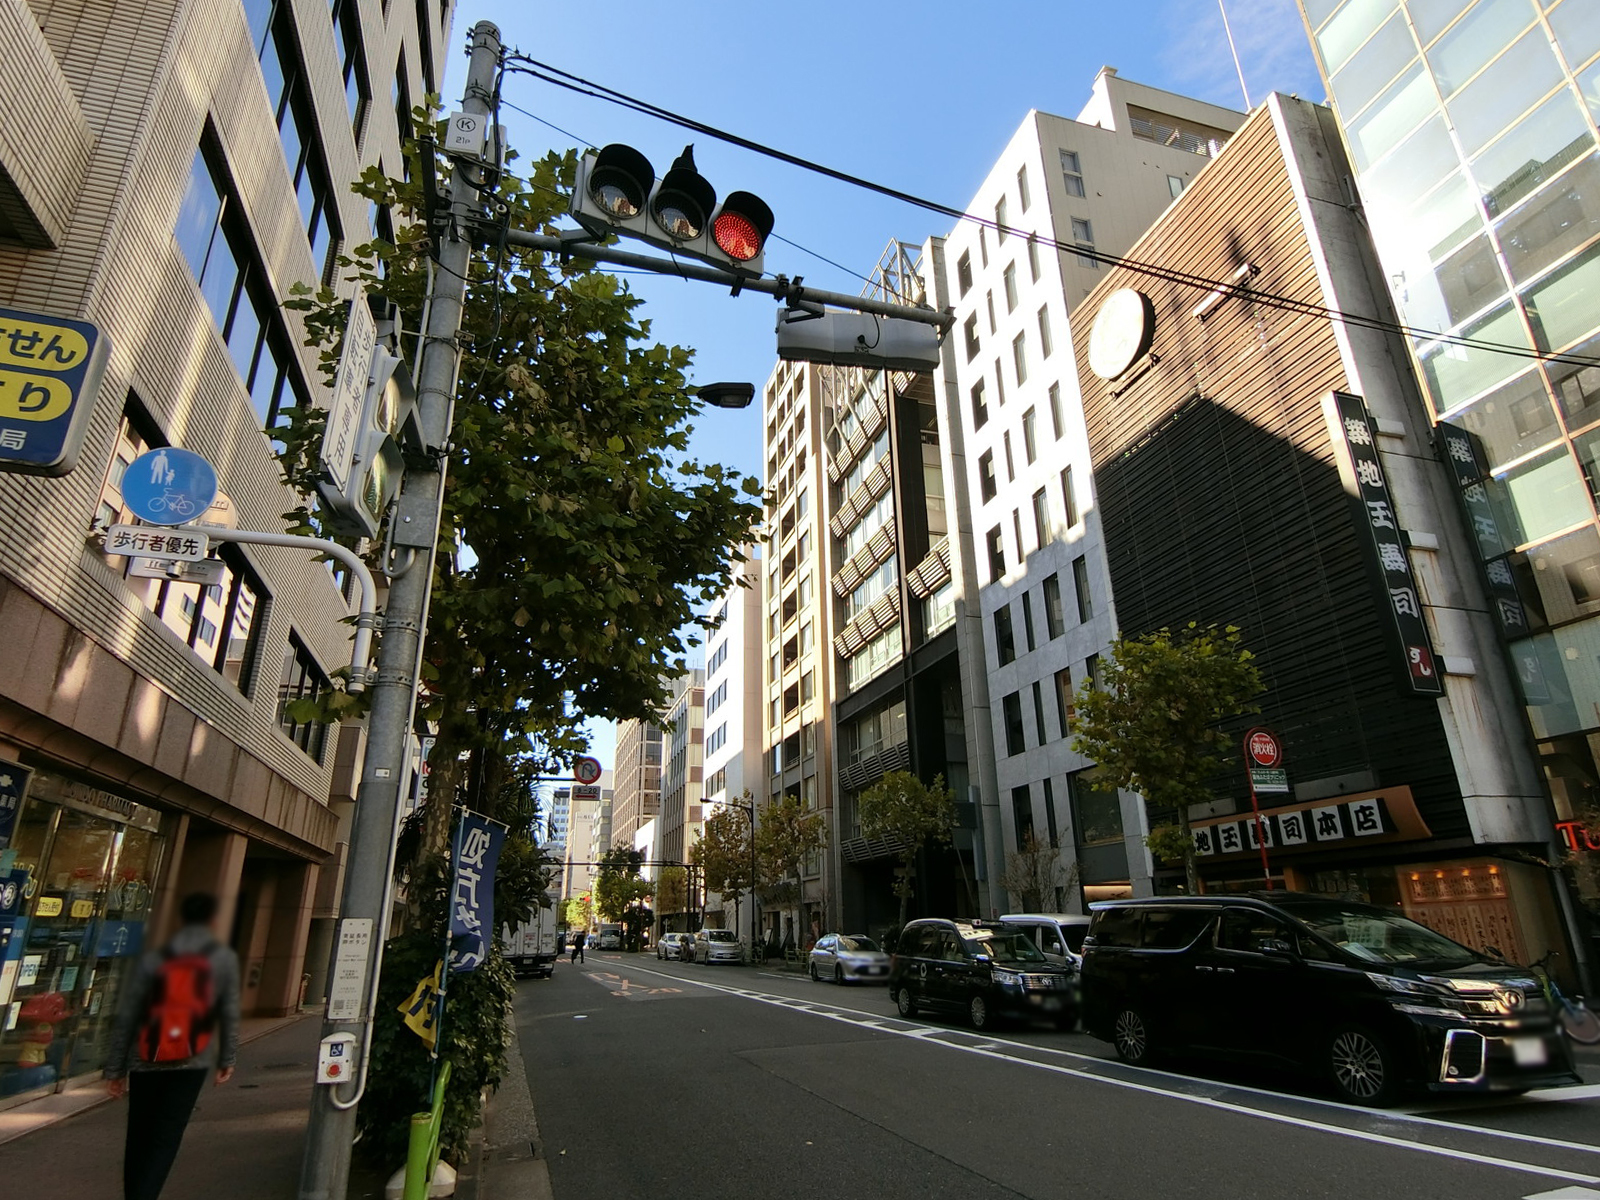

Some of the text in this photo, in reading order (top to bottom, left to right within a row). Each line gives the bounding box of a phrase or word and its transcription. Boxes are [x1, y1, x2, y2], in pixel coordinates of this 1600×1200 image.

[0, 328, 77, 364] せん
[0, 380, 52, 412] り
[113, 531, 199, 556] 歩行者優先
[1252, 742, 1275, 755] 消火栓
